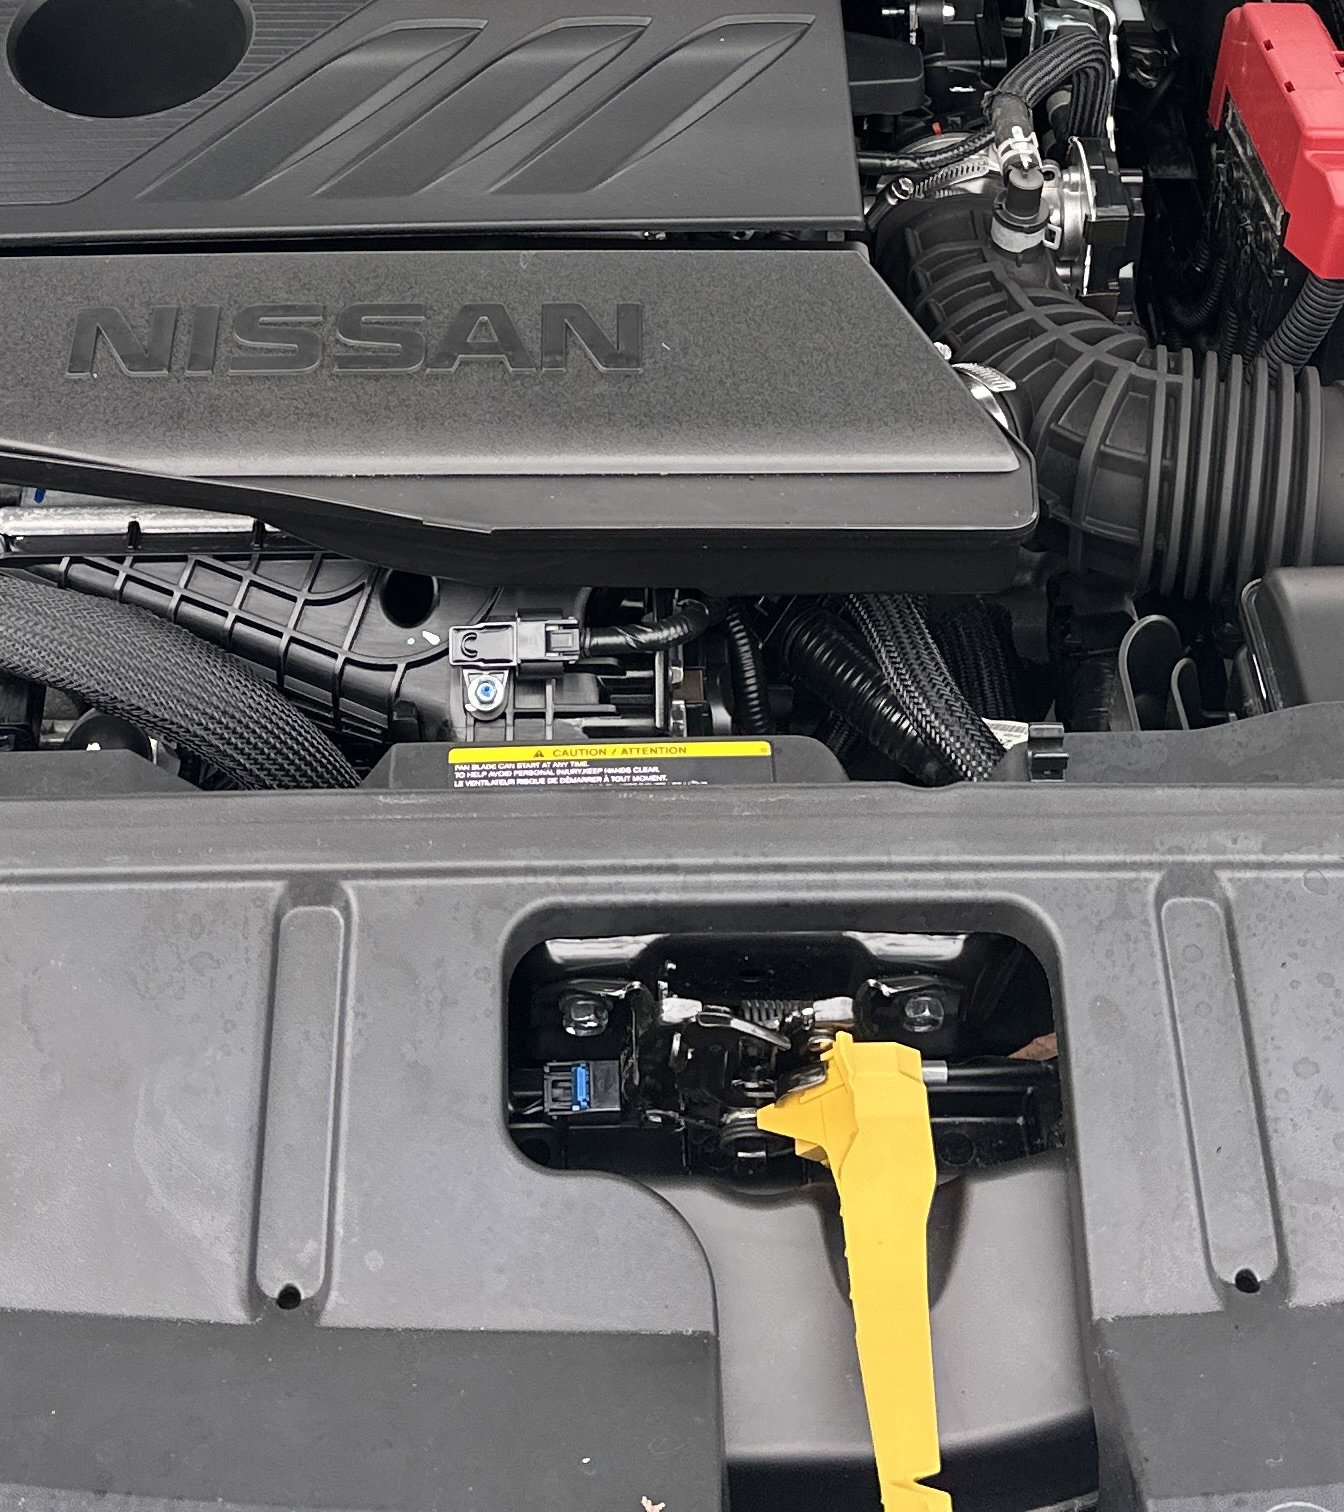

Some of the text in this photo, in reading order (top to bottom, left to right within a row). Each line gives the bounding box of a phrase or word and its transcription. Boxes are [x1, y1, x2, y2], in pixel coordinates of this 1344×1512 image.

[65, 301, 643, 378] NISSAN
[552, 748, 607, 758] CAUTION
[620, 746, 687, 756] ATTENTION
